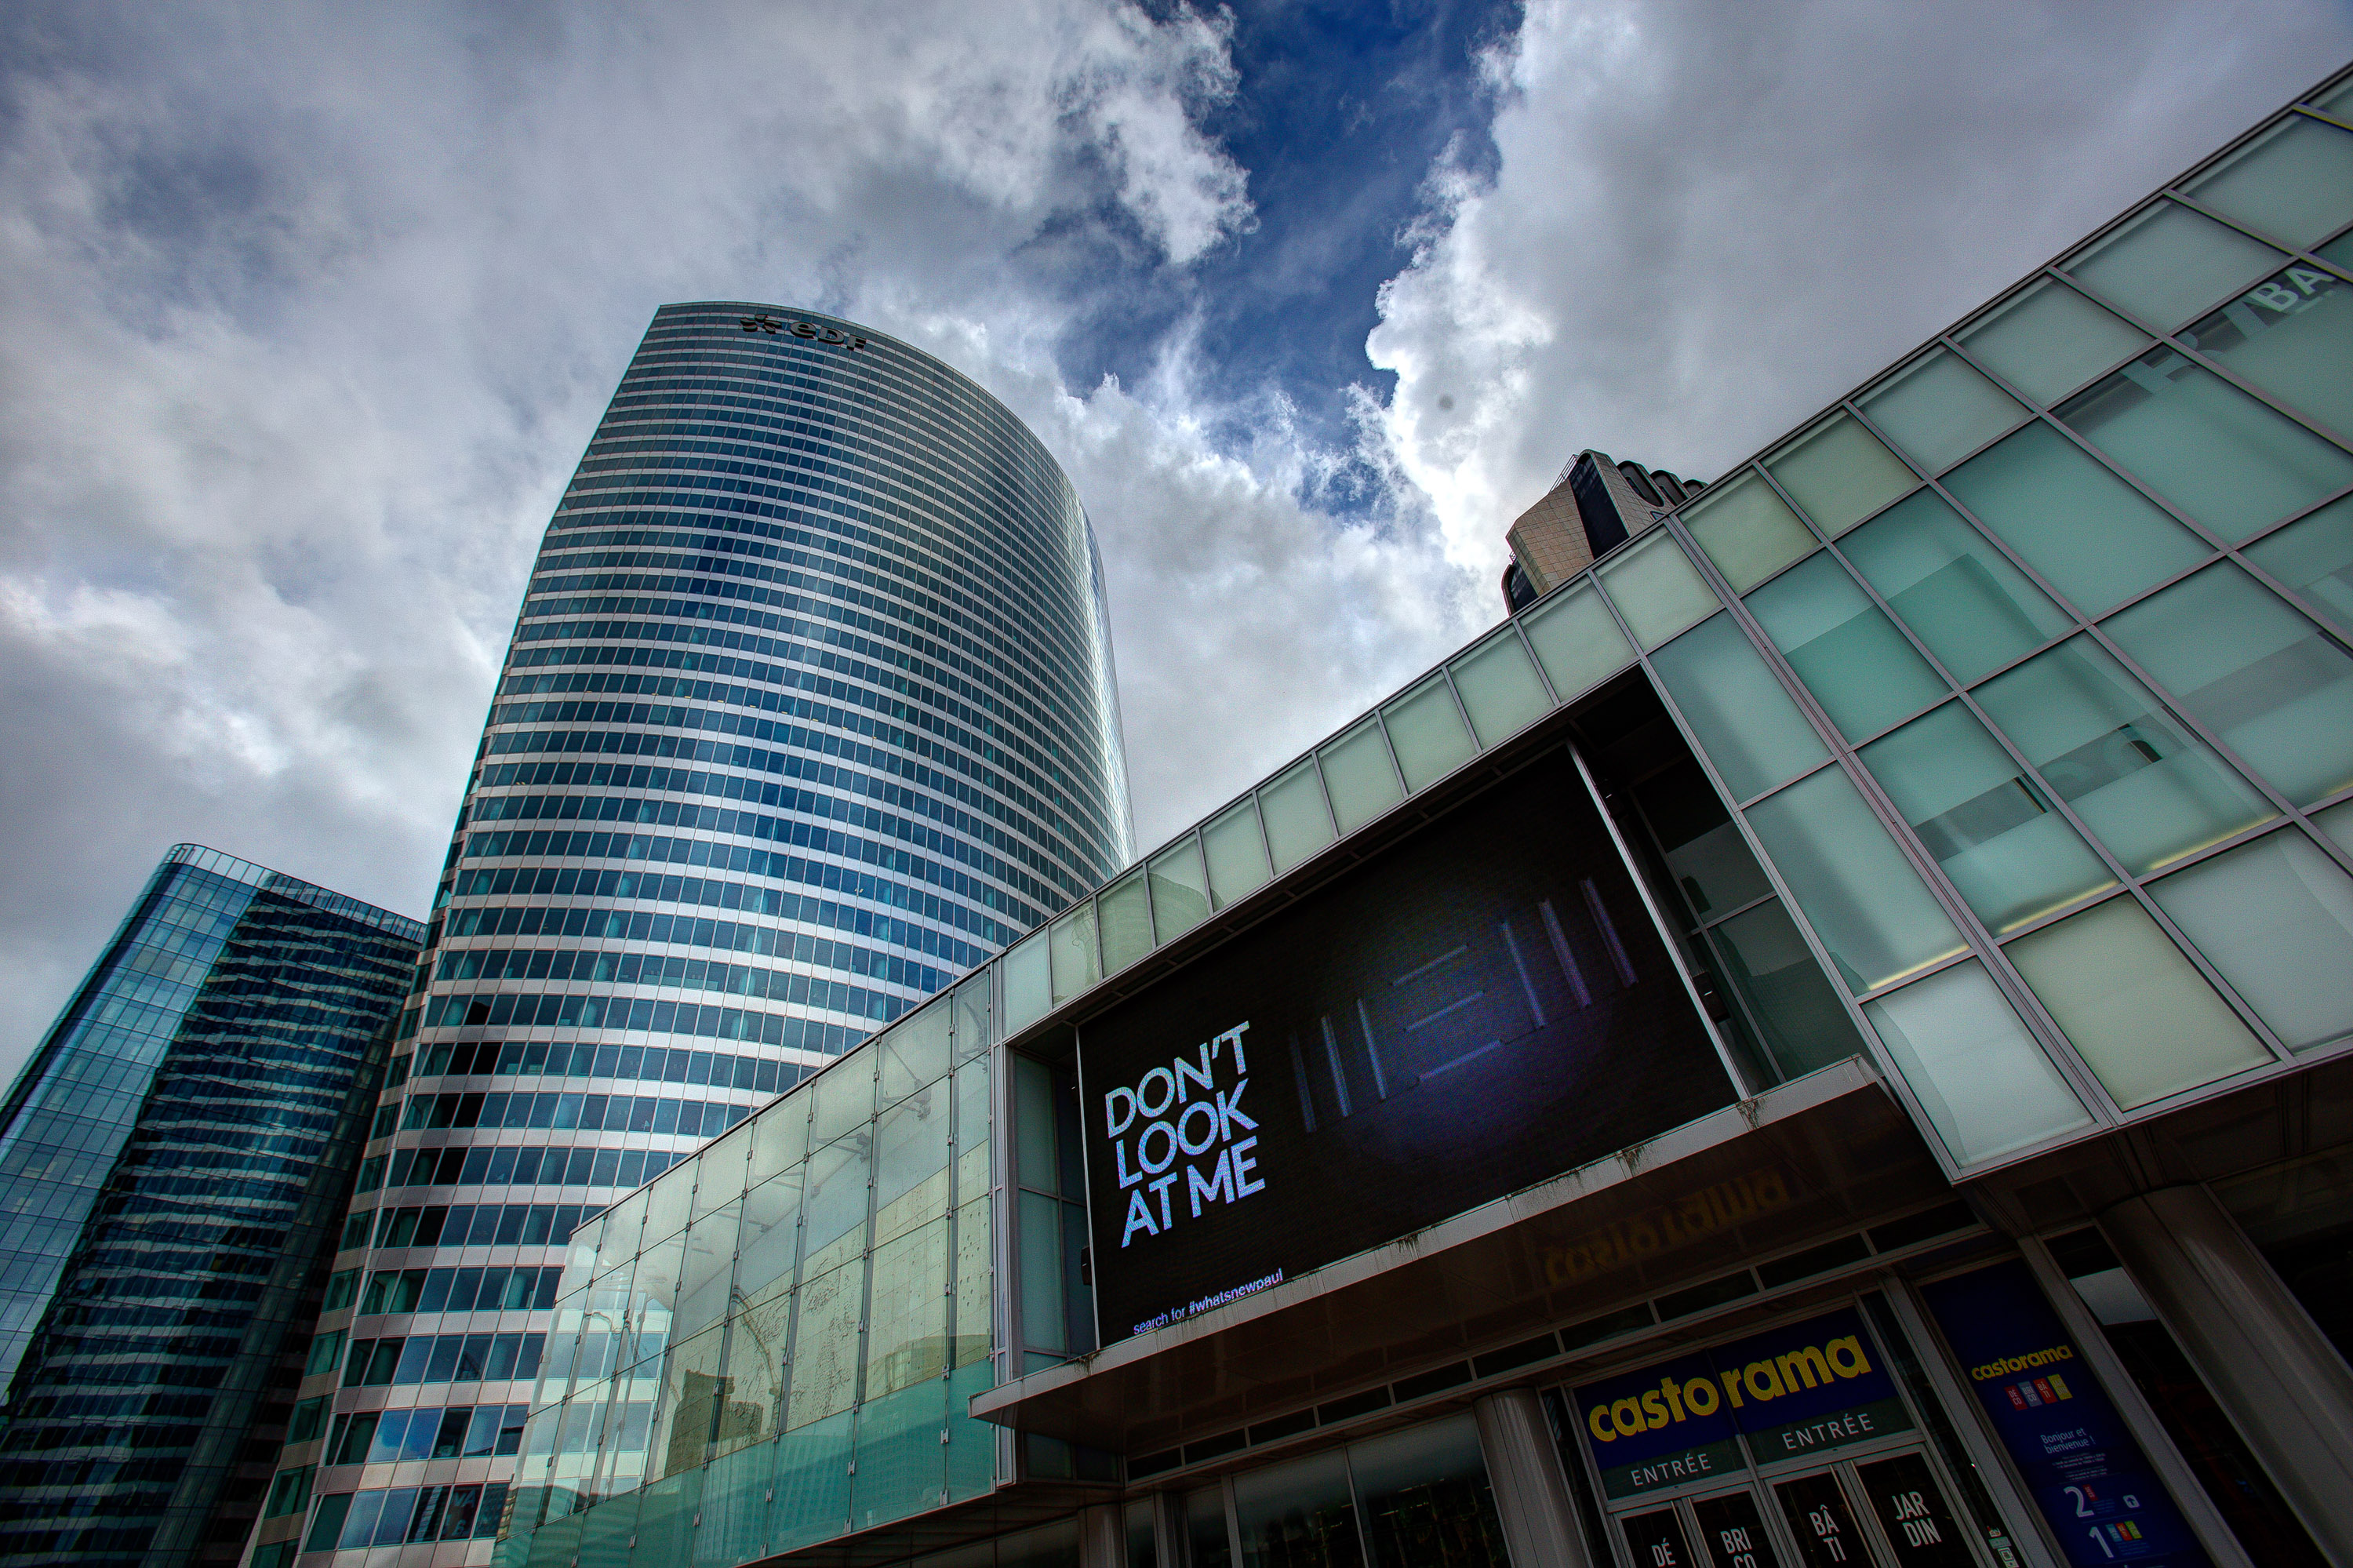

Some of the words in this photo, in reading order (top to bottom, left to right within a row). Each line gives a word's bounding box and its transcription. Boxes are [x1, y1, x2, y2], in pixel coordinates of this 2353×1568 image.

[1105, 1020, 1250, 1138] DON'T
[1116, 1078, 1259, 1189] LOOK
[1122, 1172, 1177, 1248] AT
[1187, 1136, 1266, 1218] ME
[1133, 1312, 1169, 1335] search
[1171, 1307, 1186, 1322] for
[1189, 1268, 1283, 1315] #whatsnewpaul
[1971, 1344, 2073, 1381] castorama
[1781, 1413, 1875, 1450] ENTRÉE
[2040, 1430, 2075, 1444] Bonjour
[2075, 1427, 2087, 1437] et
[2043, 1438, 2089, 1454] bienvenue
[1631, 1453, 1712, 1487] ENTRÉE
[1892, 1491, 1931, 1521] JAR
[2063, 1486, 2095, 1518] 2
[1809, 1504, 1840, 1537] BÂ
[1902, 1517, 1943, 1548] DIN
[1651, 1537, 1676, 1567] DÉ
[1720, 1526, 1753, 1555] BRI
[1823, 1536, 1847, 1563] TI
[2089, 1526, 2115, 1559] 1
